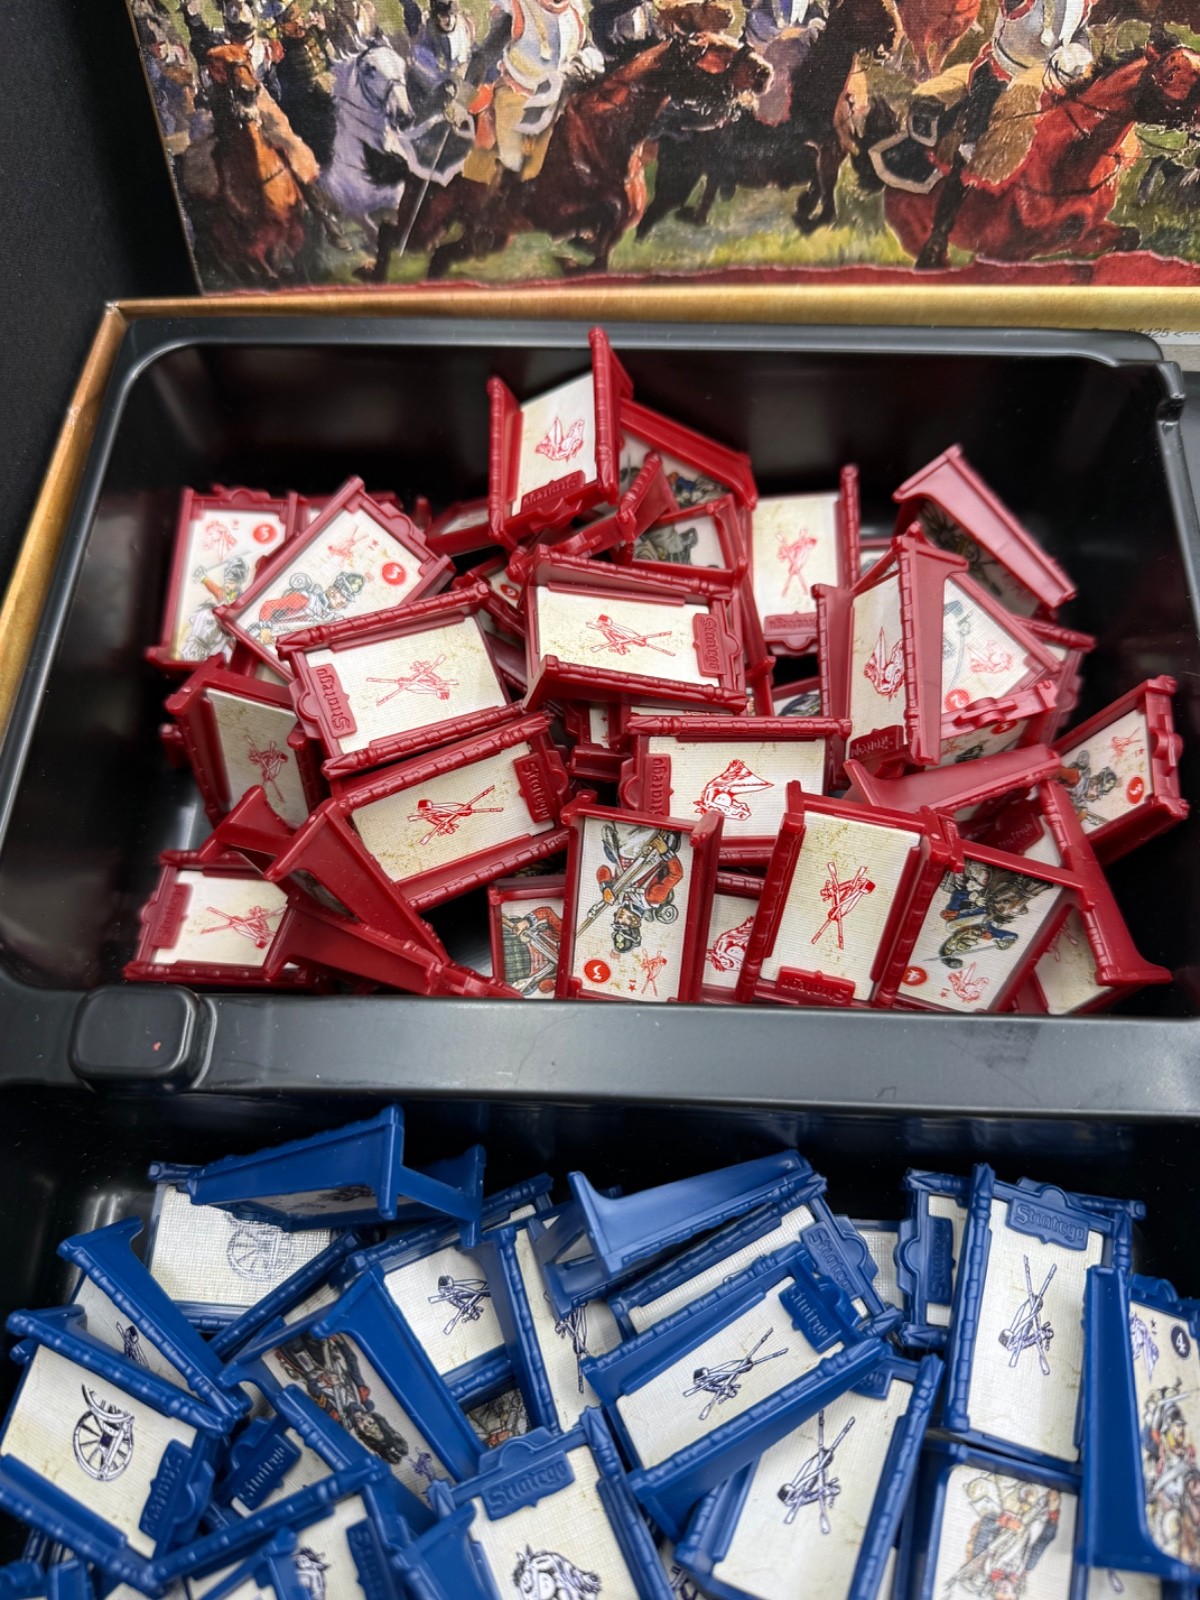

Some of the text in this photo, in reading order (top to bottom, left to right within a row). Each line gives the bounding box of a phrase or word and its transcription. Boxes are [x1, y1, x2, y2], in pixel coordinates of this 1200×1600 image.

[700, 616, 720, 671] Stratego
[315, 668, 351, 731] Stratego
[521, 762, 550, 819] Stratego
[592, 964, 602, 980] 3
[906, 969, 920, 982] 4
[1015, 1203, 1085, 1242] Stratego
[789, 1284, 830, 1337] Stratego
[1176, 1332, 1187, 1354] 4
[238, 1446, 286, 1506] Stratego
[487, 1460, 567, 1516] Stratego
